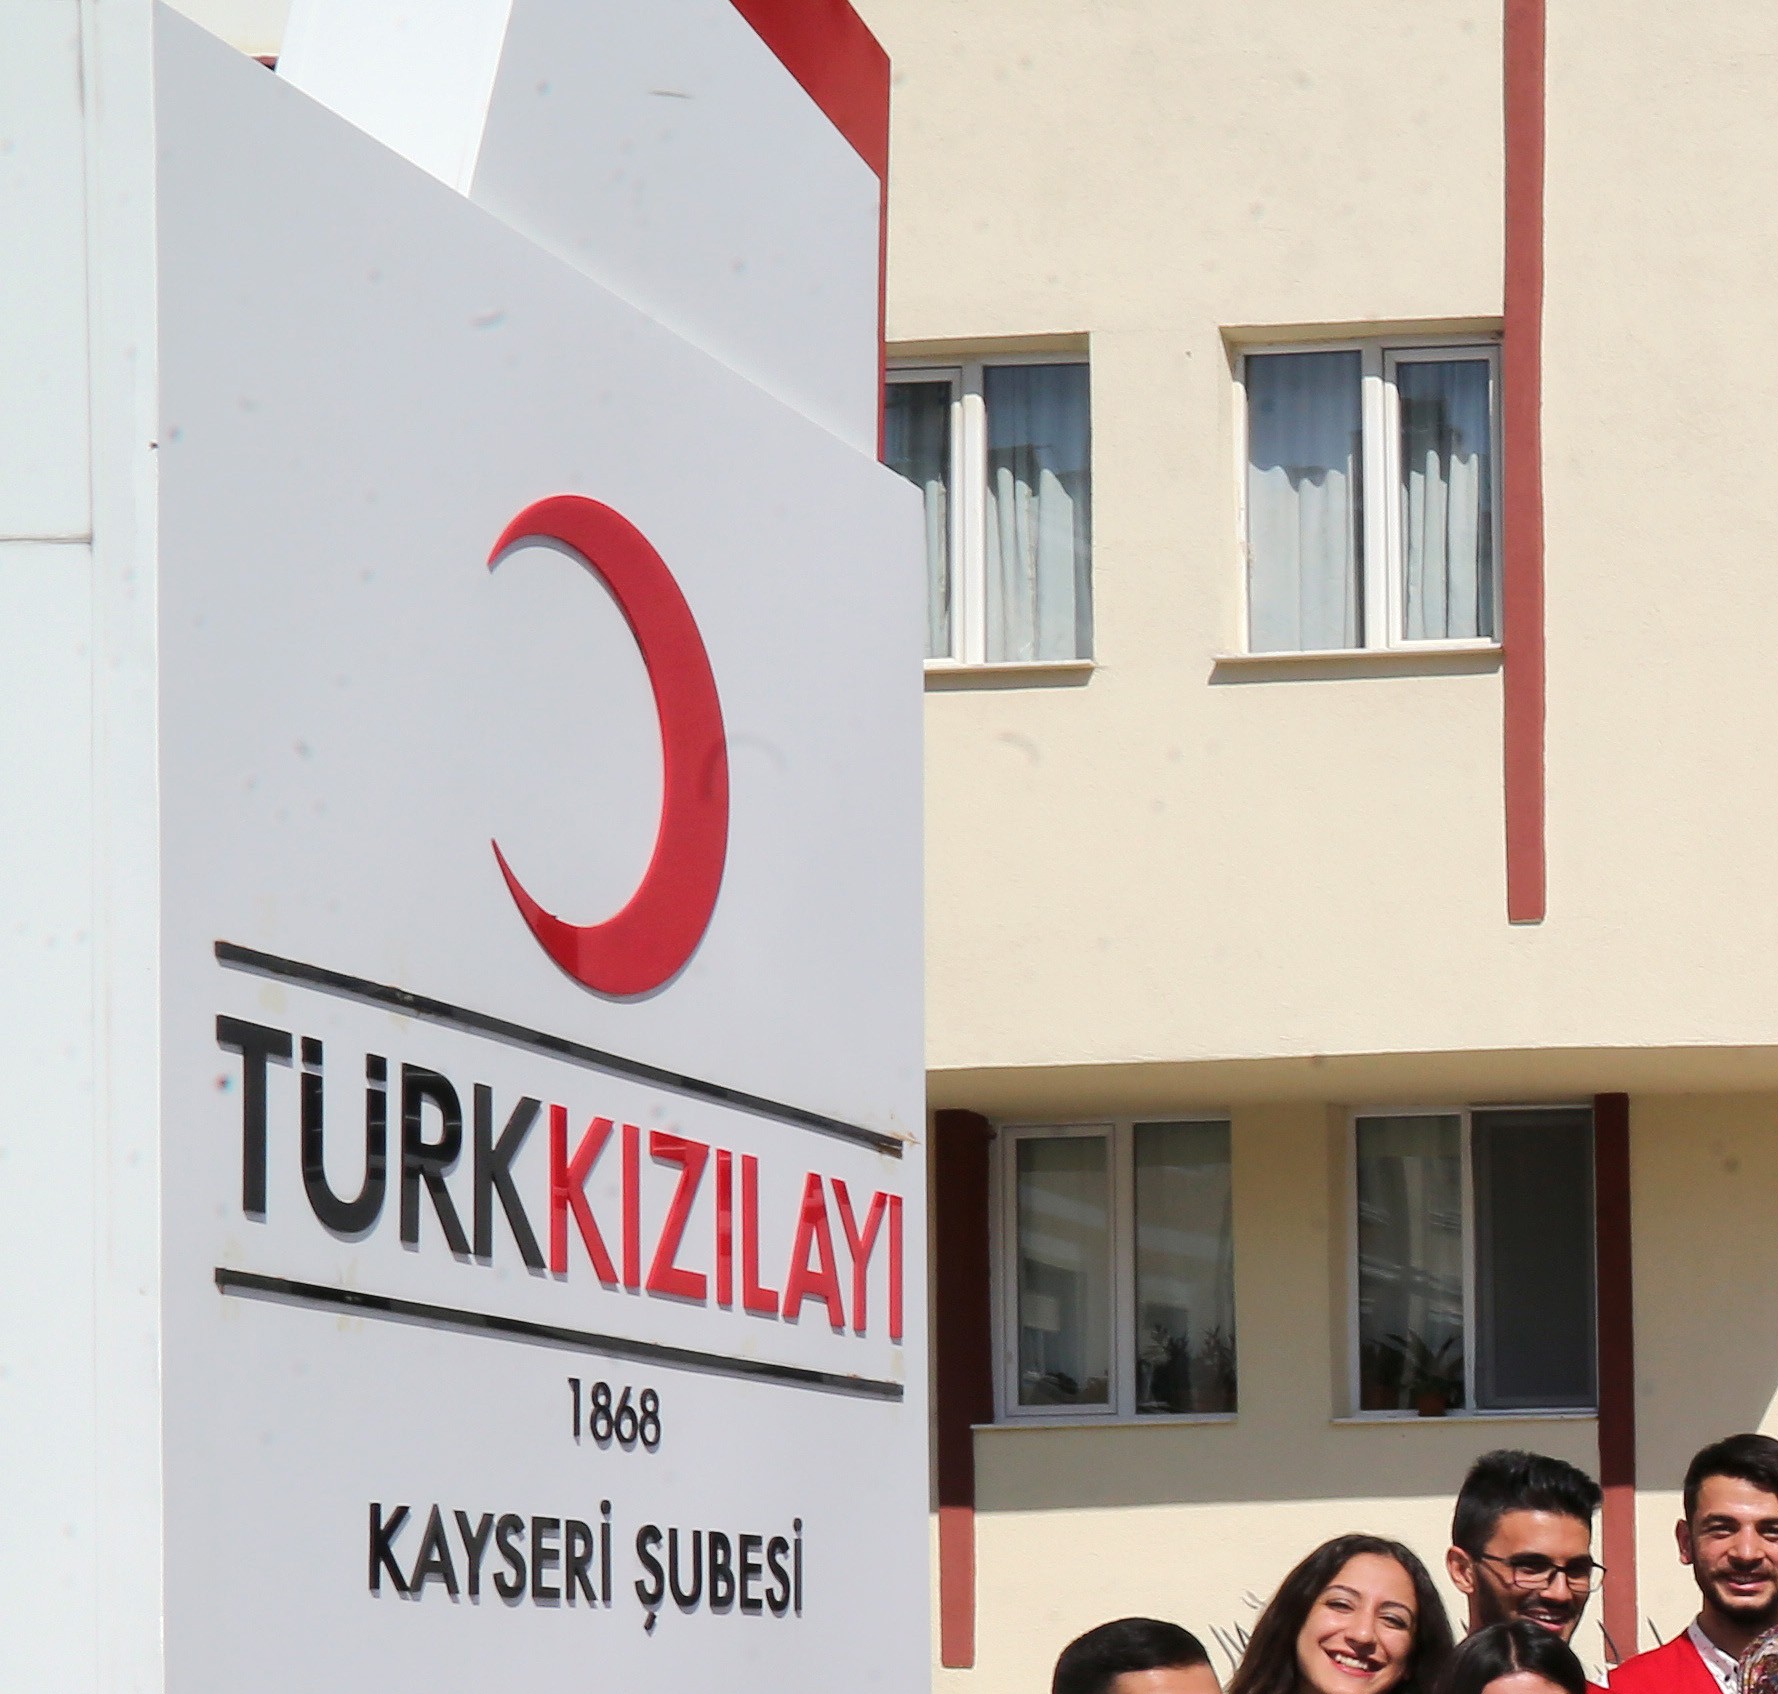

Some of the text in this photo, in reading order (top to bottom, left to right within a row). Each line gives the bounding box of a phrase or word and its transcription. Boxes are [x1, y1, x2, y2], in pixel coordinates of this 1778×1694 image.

[568, 1377, 663, 1449] 1868
[369, 1499, 804, 1633] KAYSERİ ŞUBESİ
